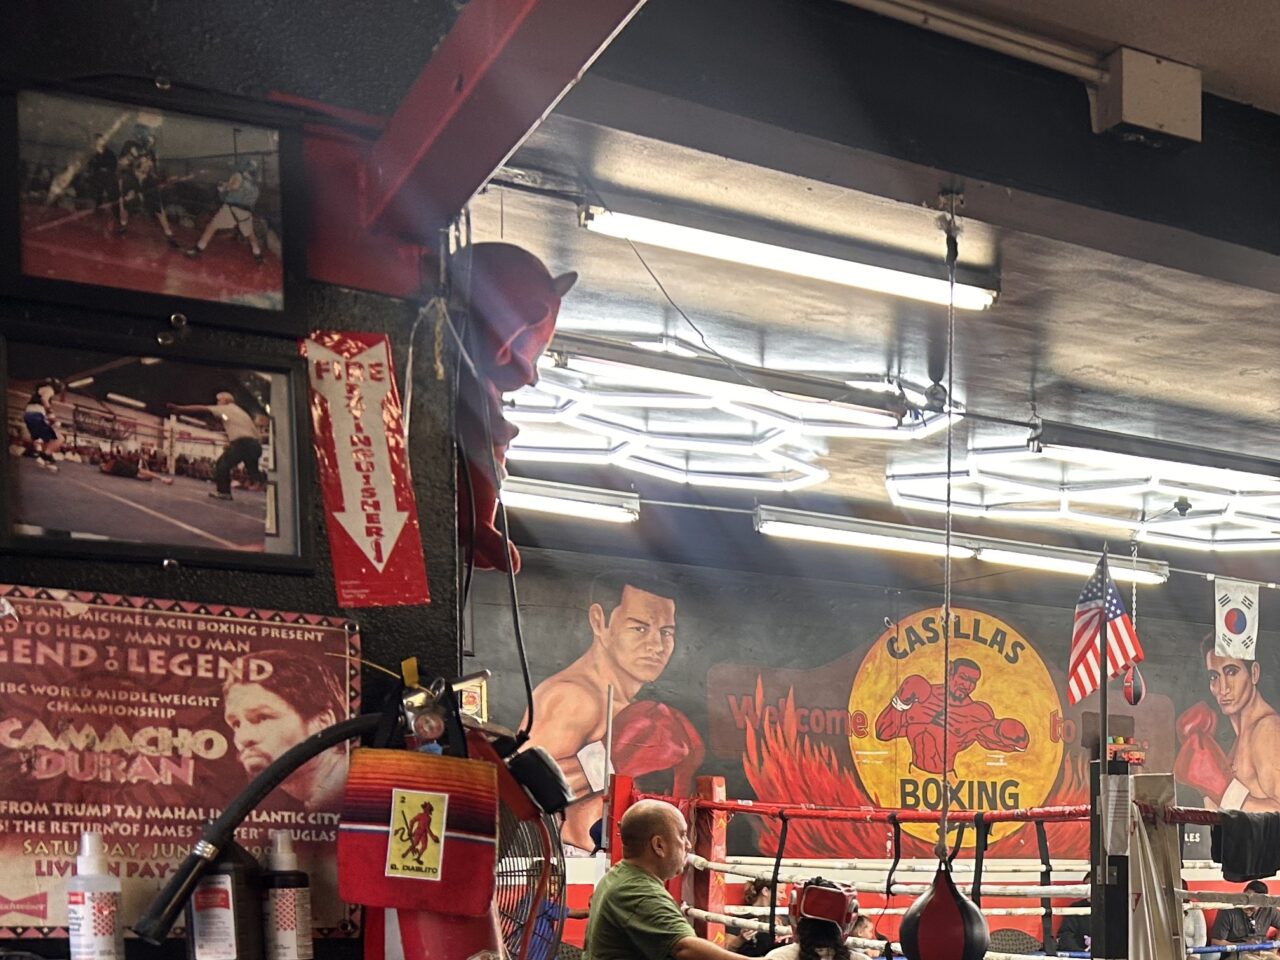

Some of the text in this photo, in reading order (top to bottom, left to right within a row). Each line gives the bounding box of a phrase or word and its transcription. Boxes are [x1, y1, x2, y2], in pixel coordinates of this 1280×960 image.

[23, 621, 51, 635] TO
[56, 624, 110, 640] HEAD
[125, 632, 171, 646] MAN
[176, 635, 201, 648] TO
[205, 638, 250, 652] MAN
[79, 611, 152, 626] MICHAEL
[155, 618, 192, 630] ACRI
[197, 621, 257, 636] BOXING
[261, 628, 325, 642] PRESENT
[128, 647, 274, 682] LEGEND
[31, 684, 92, 698] WORLD
[96, 689, 220, 708] MIDDLEWEIGHT
[47, 701, 176, 719] CHAMPIONSHIP
[728, 694, 1077, 743] Welcome to
[0, 717, 229, 760] CAMACHO
[33, 749, 195, 786] DURAN
[900, 778, 1021, 810] BOXING
[0, 800, 49, 816] FROM
[52, 802, 111, 818] TRUMP
[114, 804, 142, 819] TAJ
[146, 806, 206, 820] MAHAL
[308, 812, 341, 825] CITY
[13, 820, 46, 833] THE
[50, 821, 114, 835] RETURN
[119, 824, 141, 837] OF
[144, 825, 192, 838] JAMES
[402, 864, 439, 874] DIABLITO
